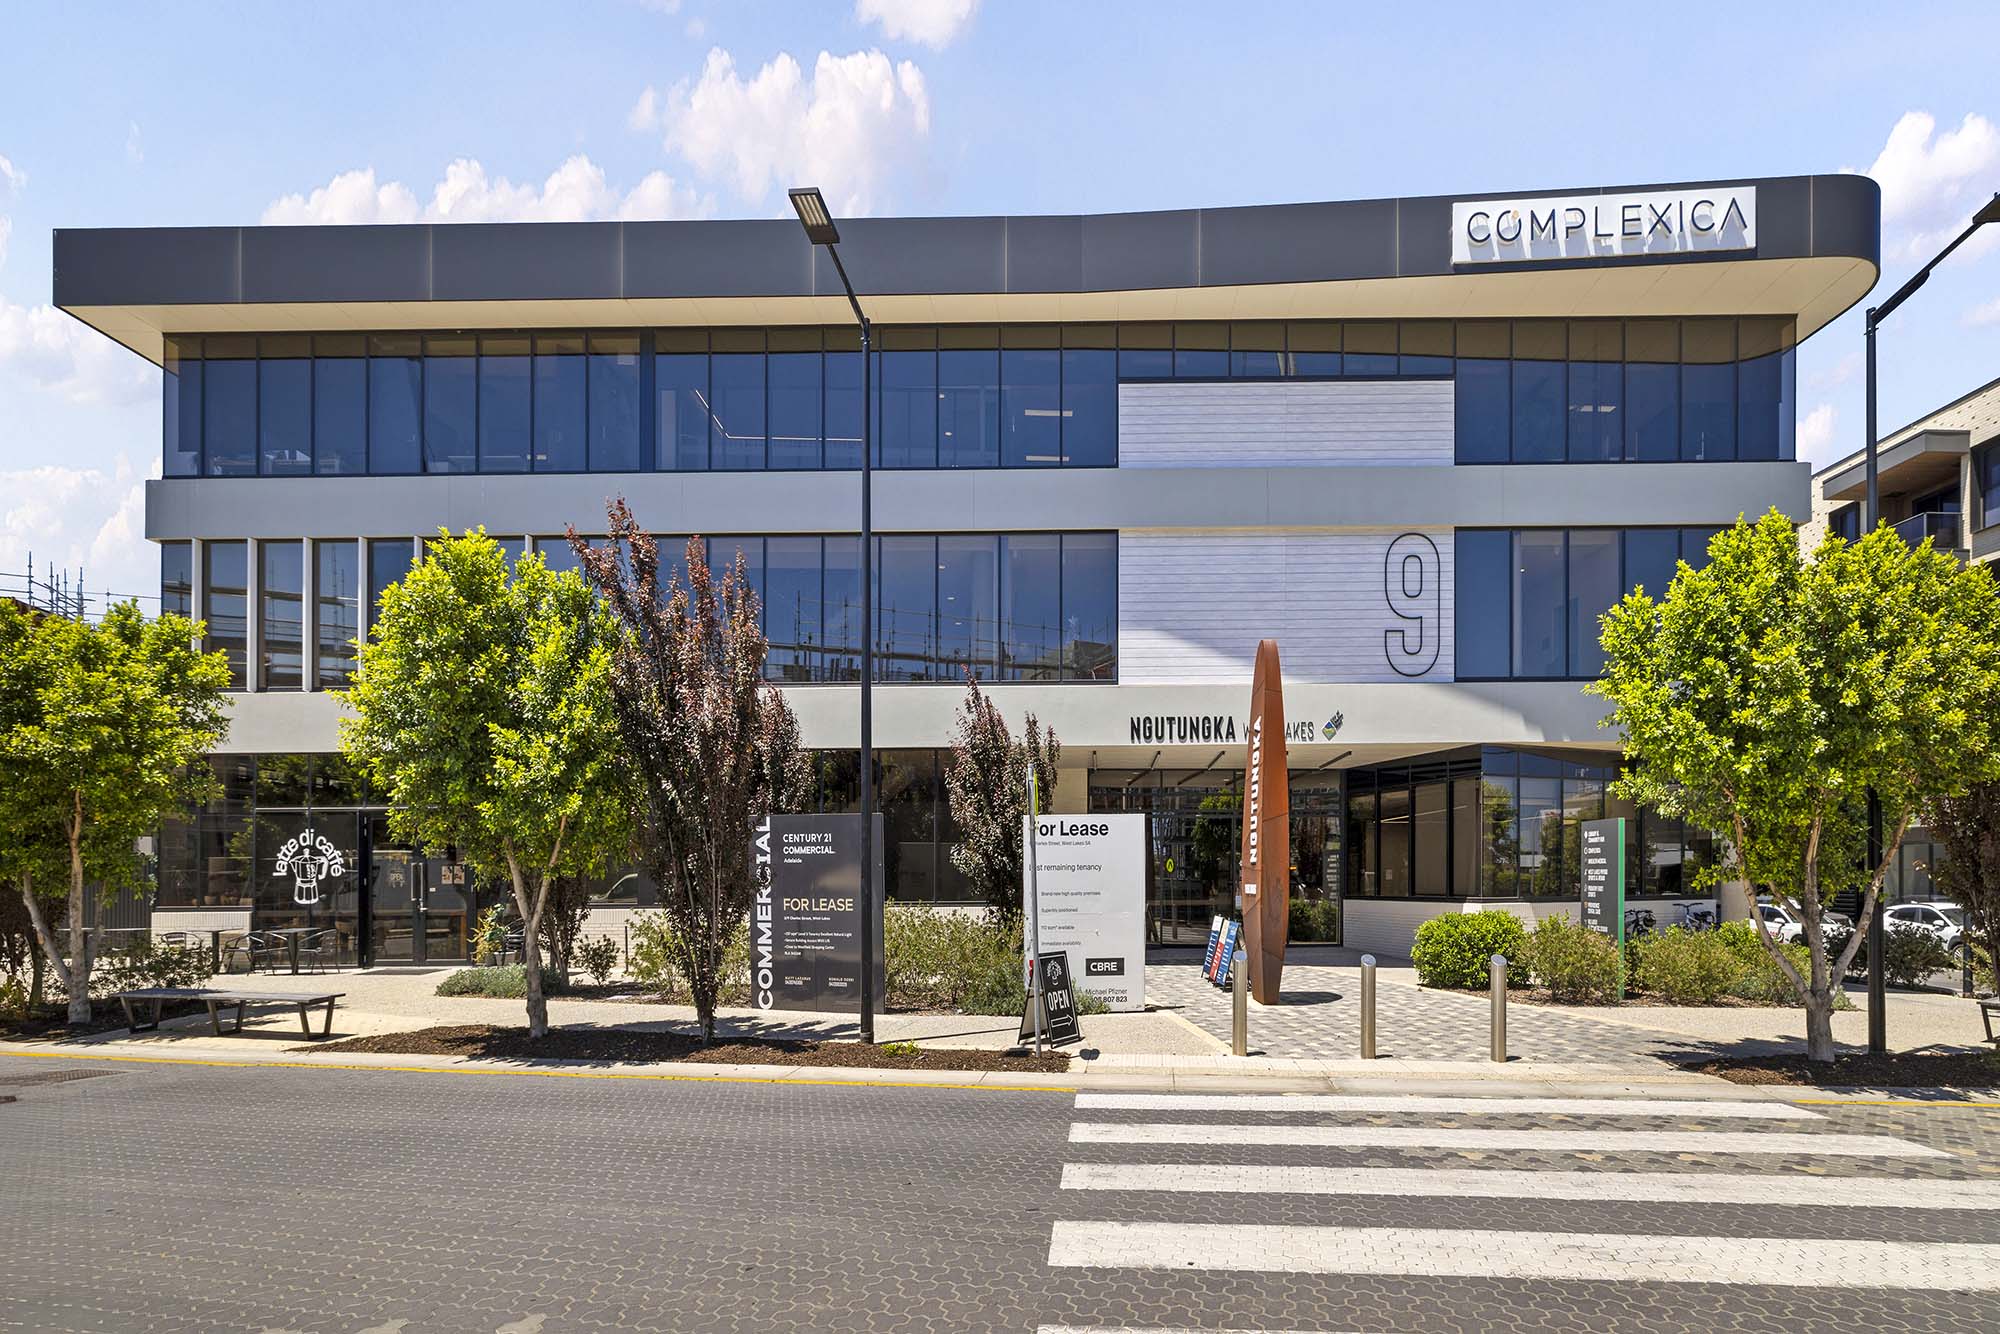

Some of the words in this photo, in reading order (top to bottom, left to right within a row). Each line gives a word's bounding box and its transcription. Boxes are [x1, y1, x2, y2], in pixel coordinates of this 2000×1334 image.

[1467, 197, 1748, 243] COMPLEXICA
[1385, 532, 1441, 677] 9
[1130, 716, 1236, 742] NGUTUNGKA
[1286, 721, 1315, 741] AKES
[1250, 716, 1262, 863] NGUTUNGKA
[783, 833, 822, 843] CENTURY
[823, 833, 832, 843] 21
[1034, 821, 1056, 837] or
[1060, 820, 1109, 837] Lease
[272, 838, 299, 877] latte
[299, 828, 315, 847] di
[1044, 863, 1076, 873] remaining
[1077, 863, 1103, 873] tenancy
[783, 898, 810, 911] FOR
[812, 898, 854, 912] LEASE
[1090, 962, 1118, 972] CBRE
[1047, 989, 1070, 1012] OPEN
